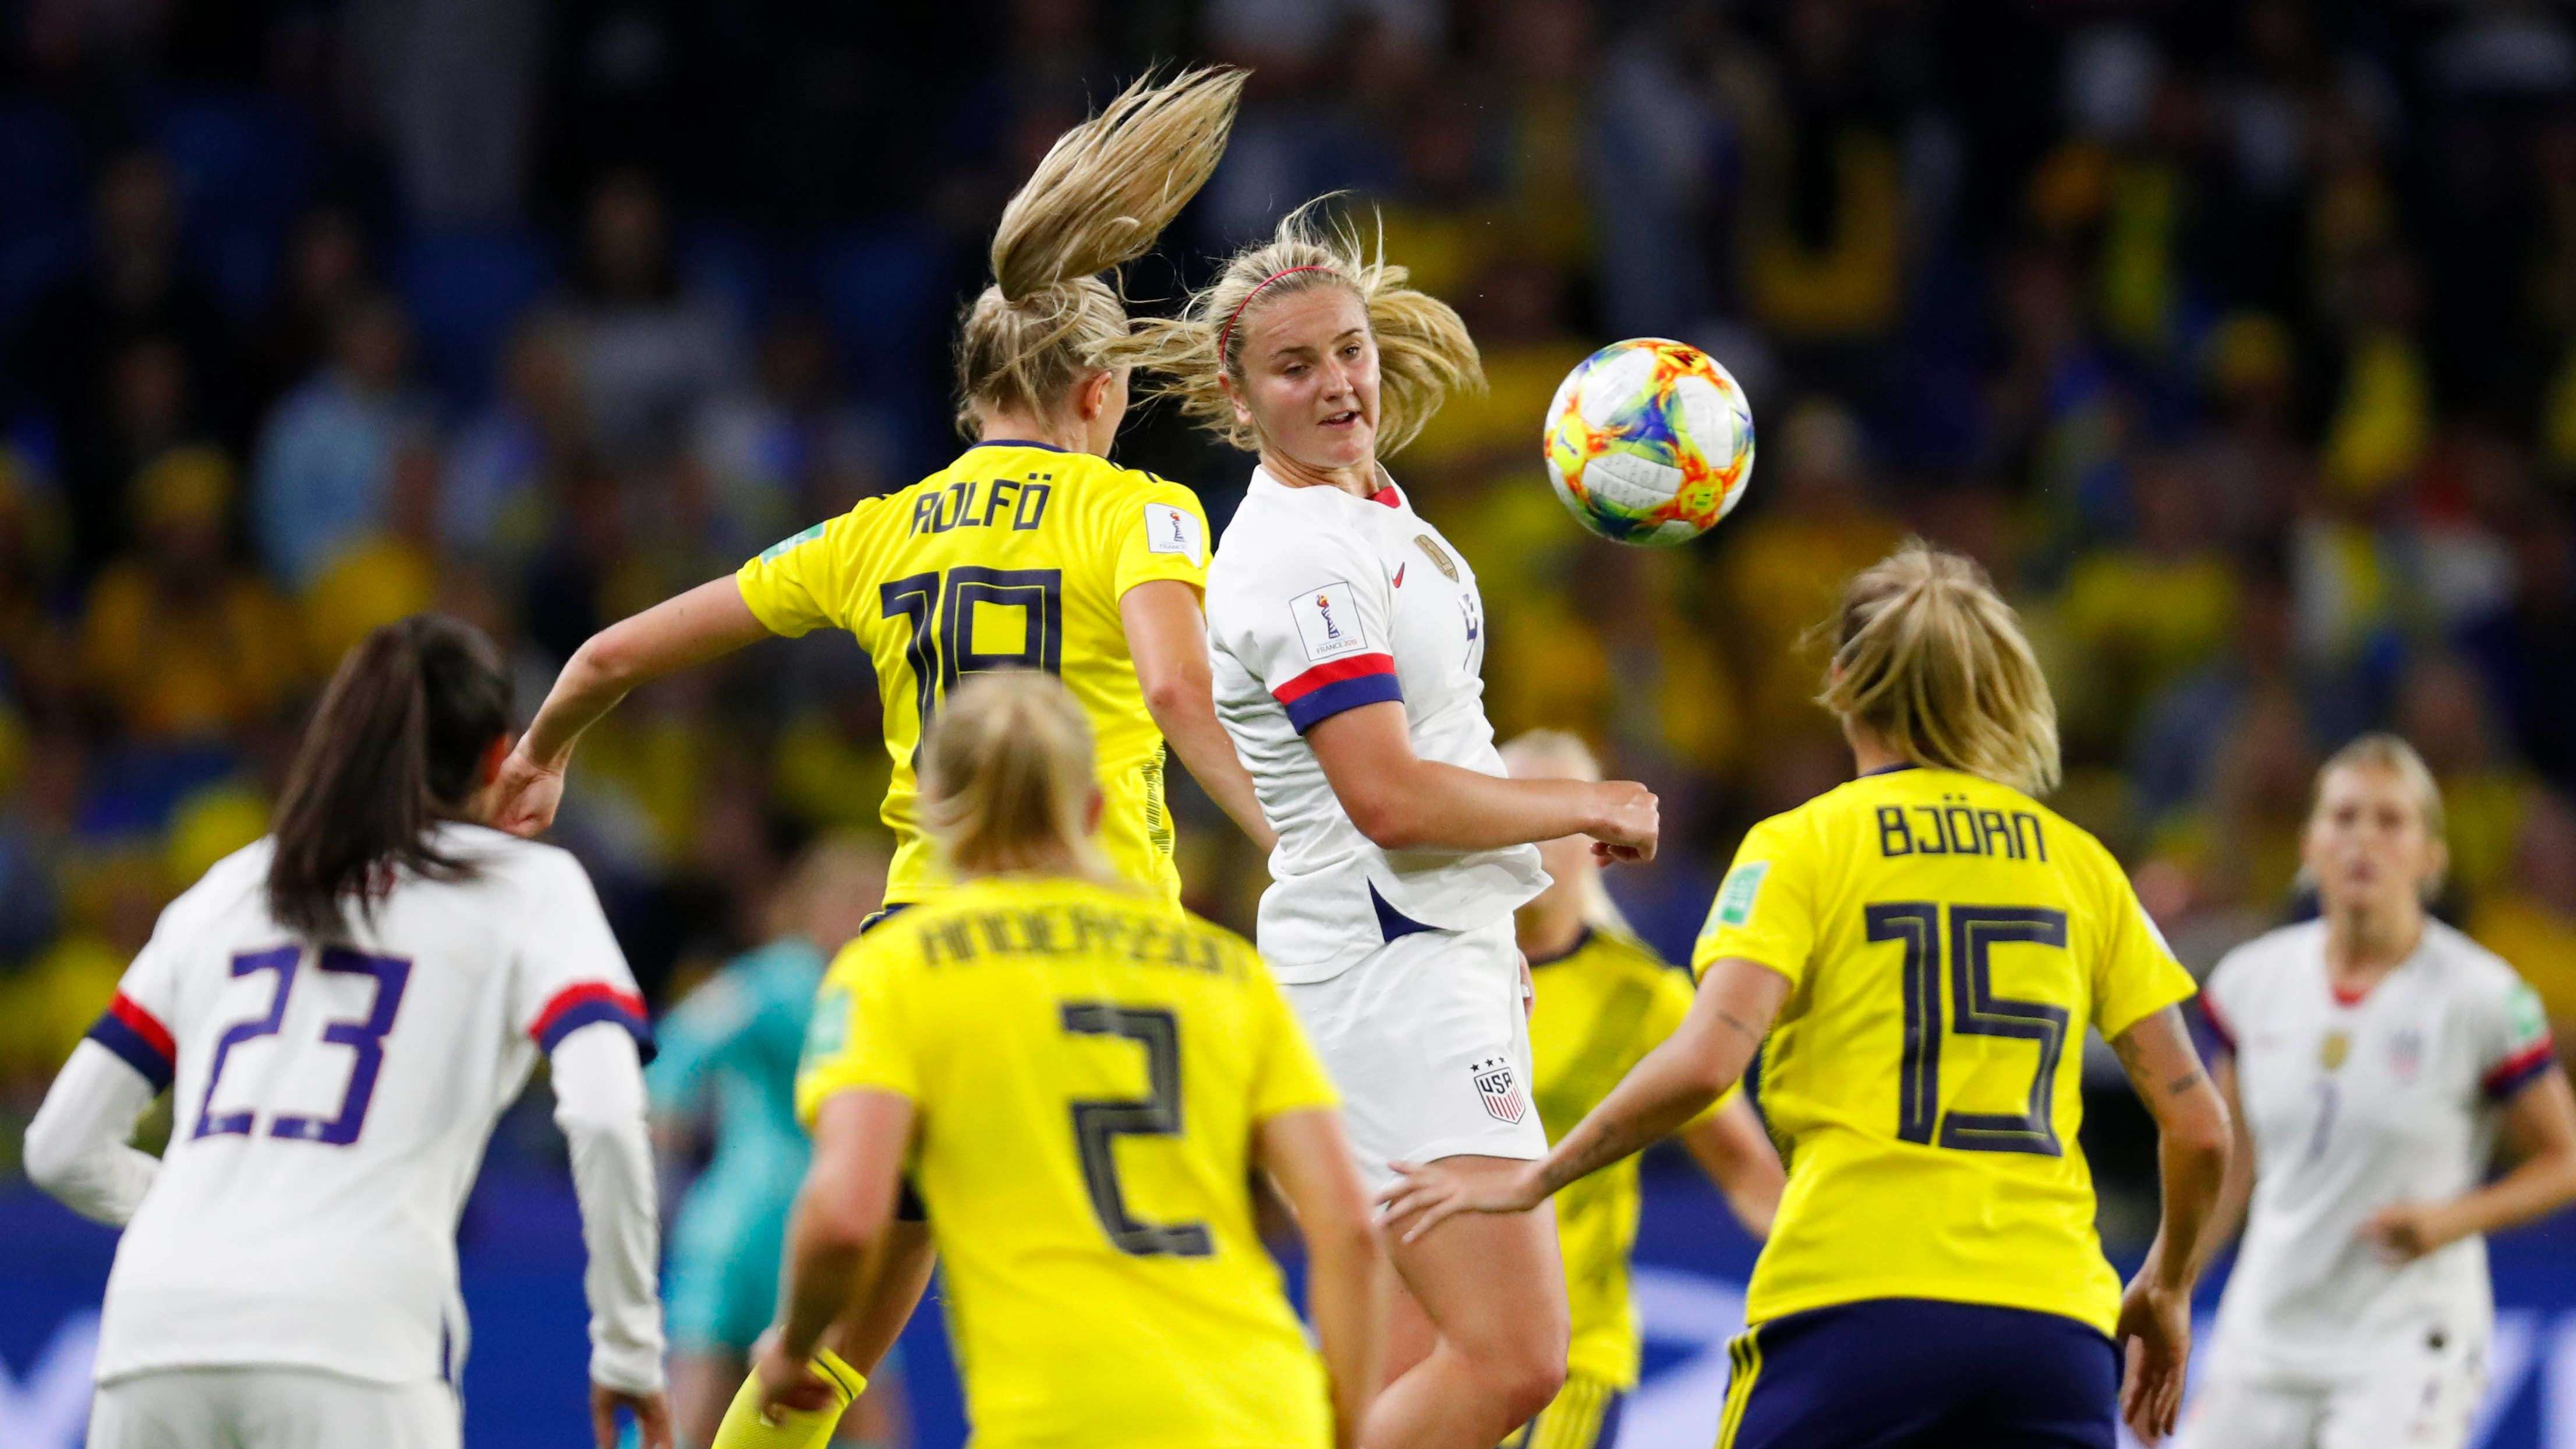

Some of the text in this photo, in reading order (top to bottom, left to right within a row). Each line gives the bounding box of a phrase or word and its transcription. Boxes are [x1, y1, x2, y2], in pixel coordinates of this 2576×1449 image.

[909, 473, 1052, 539] ROLFÖ
[1317, 642, 1343, 654] FRANCE
[1876, 793, 2047, 863] BJÖRN
[190, 944, 415, 1147] 23
[1863, 901, 2070, 1157] 15
[1480, 1071, 1513, 1094] USA
[1059, 1001, 1215, 1259] 2
